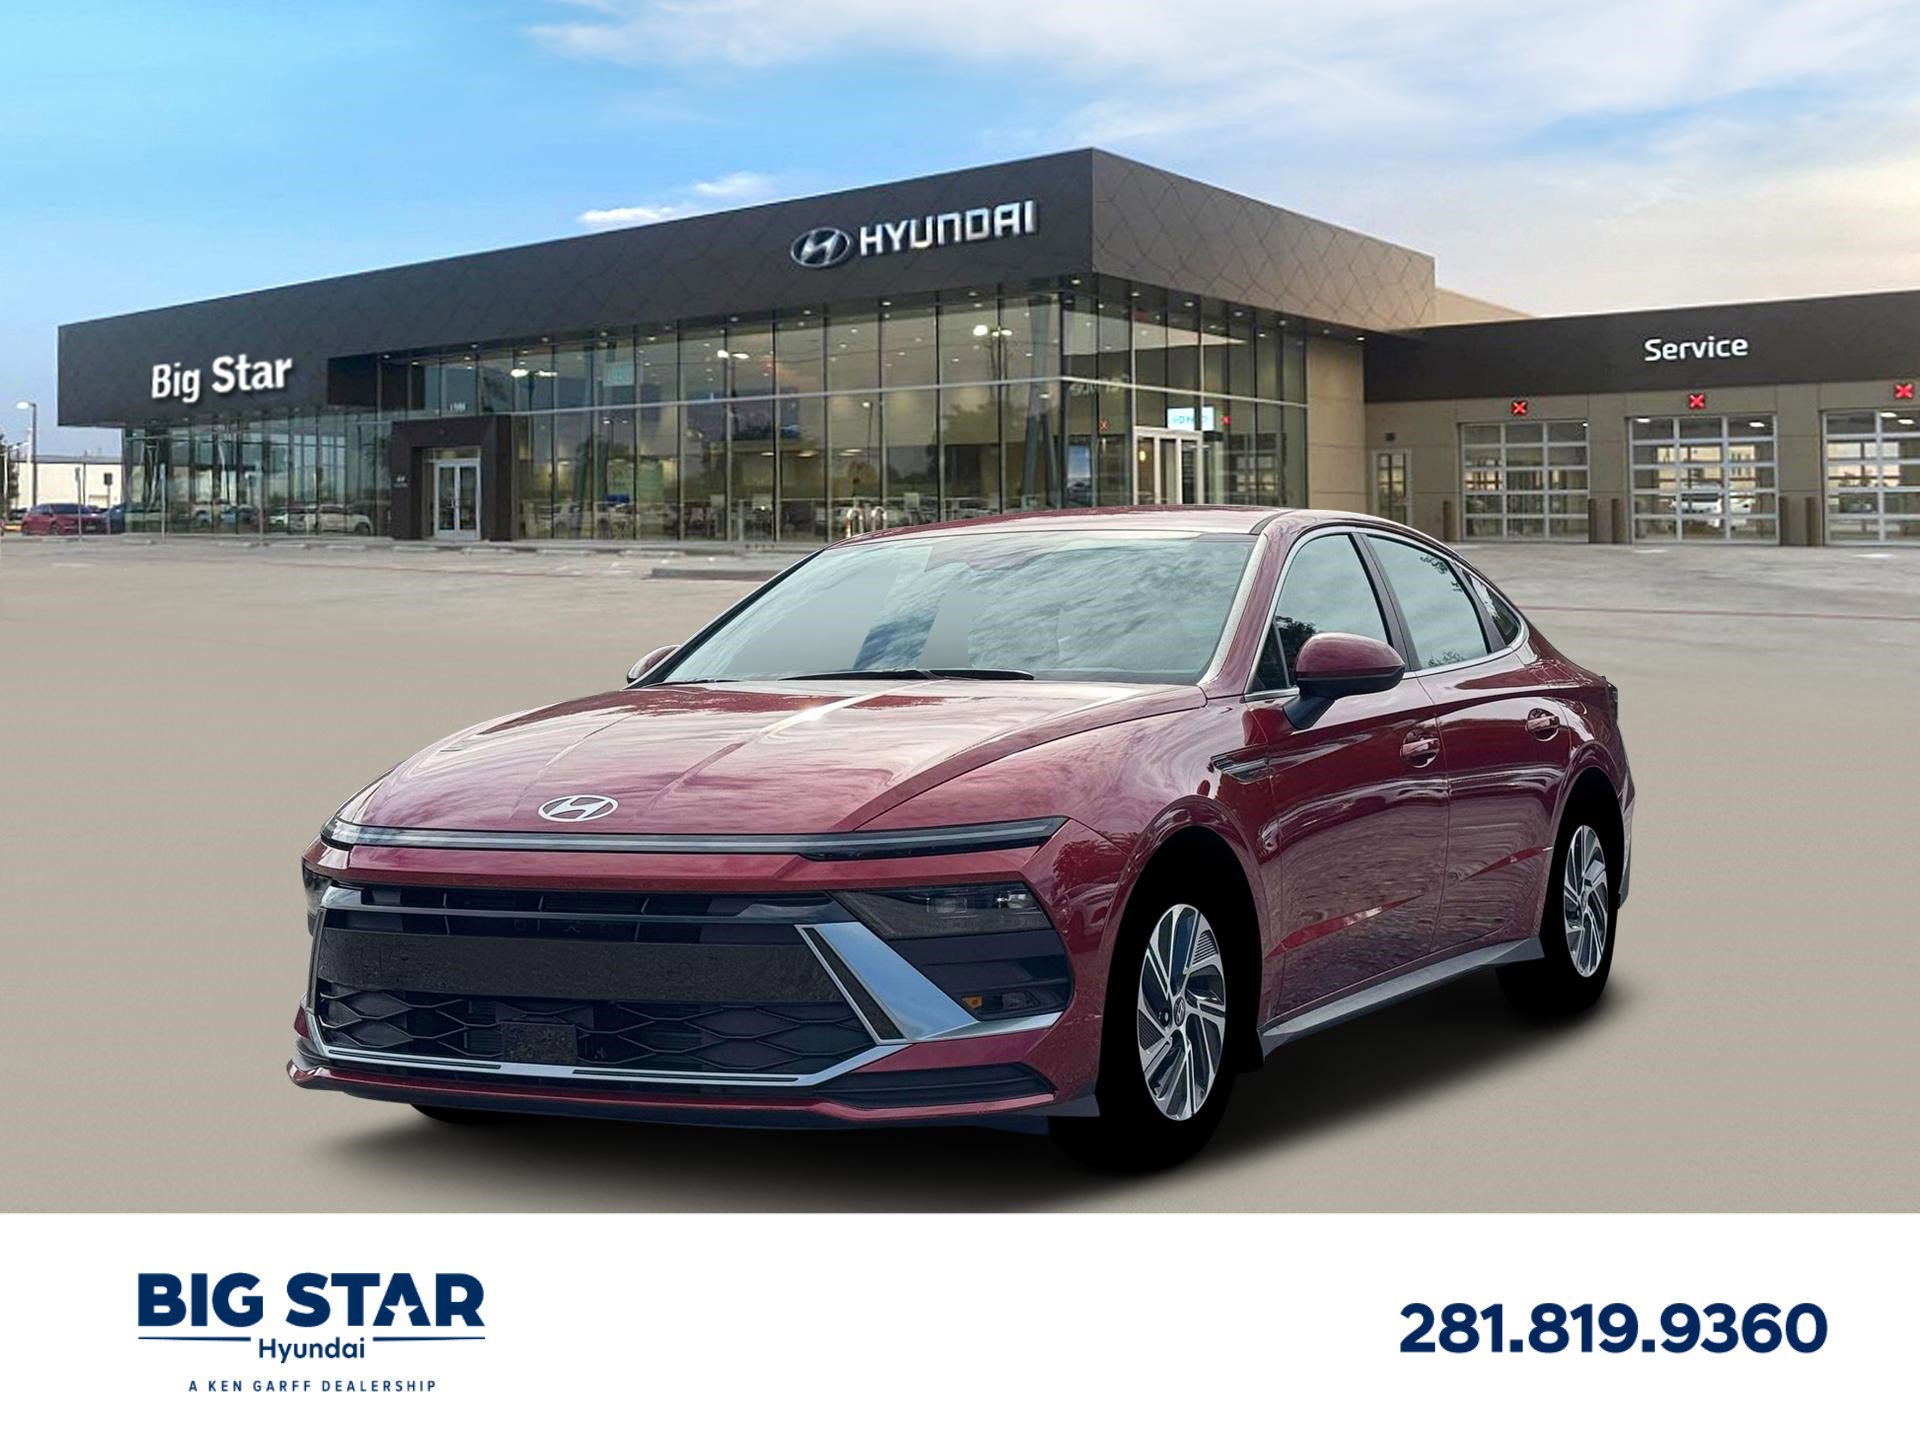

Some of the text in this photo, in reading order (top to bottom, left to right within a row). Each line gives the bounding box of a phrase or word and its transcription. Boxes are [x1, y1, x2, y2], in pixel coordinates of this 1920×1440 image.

[860, 200, 1035, 256] HYUNDAI
[1644, 335, 1748, 361] Service
[151, 353, 293, 403] Big Star
